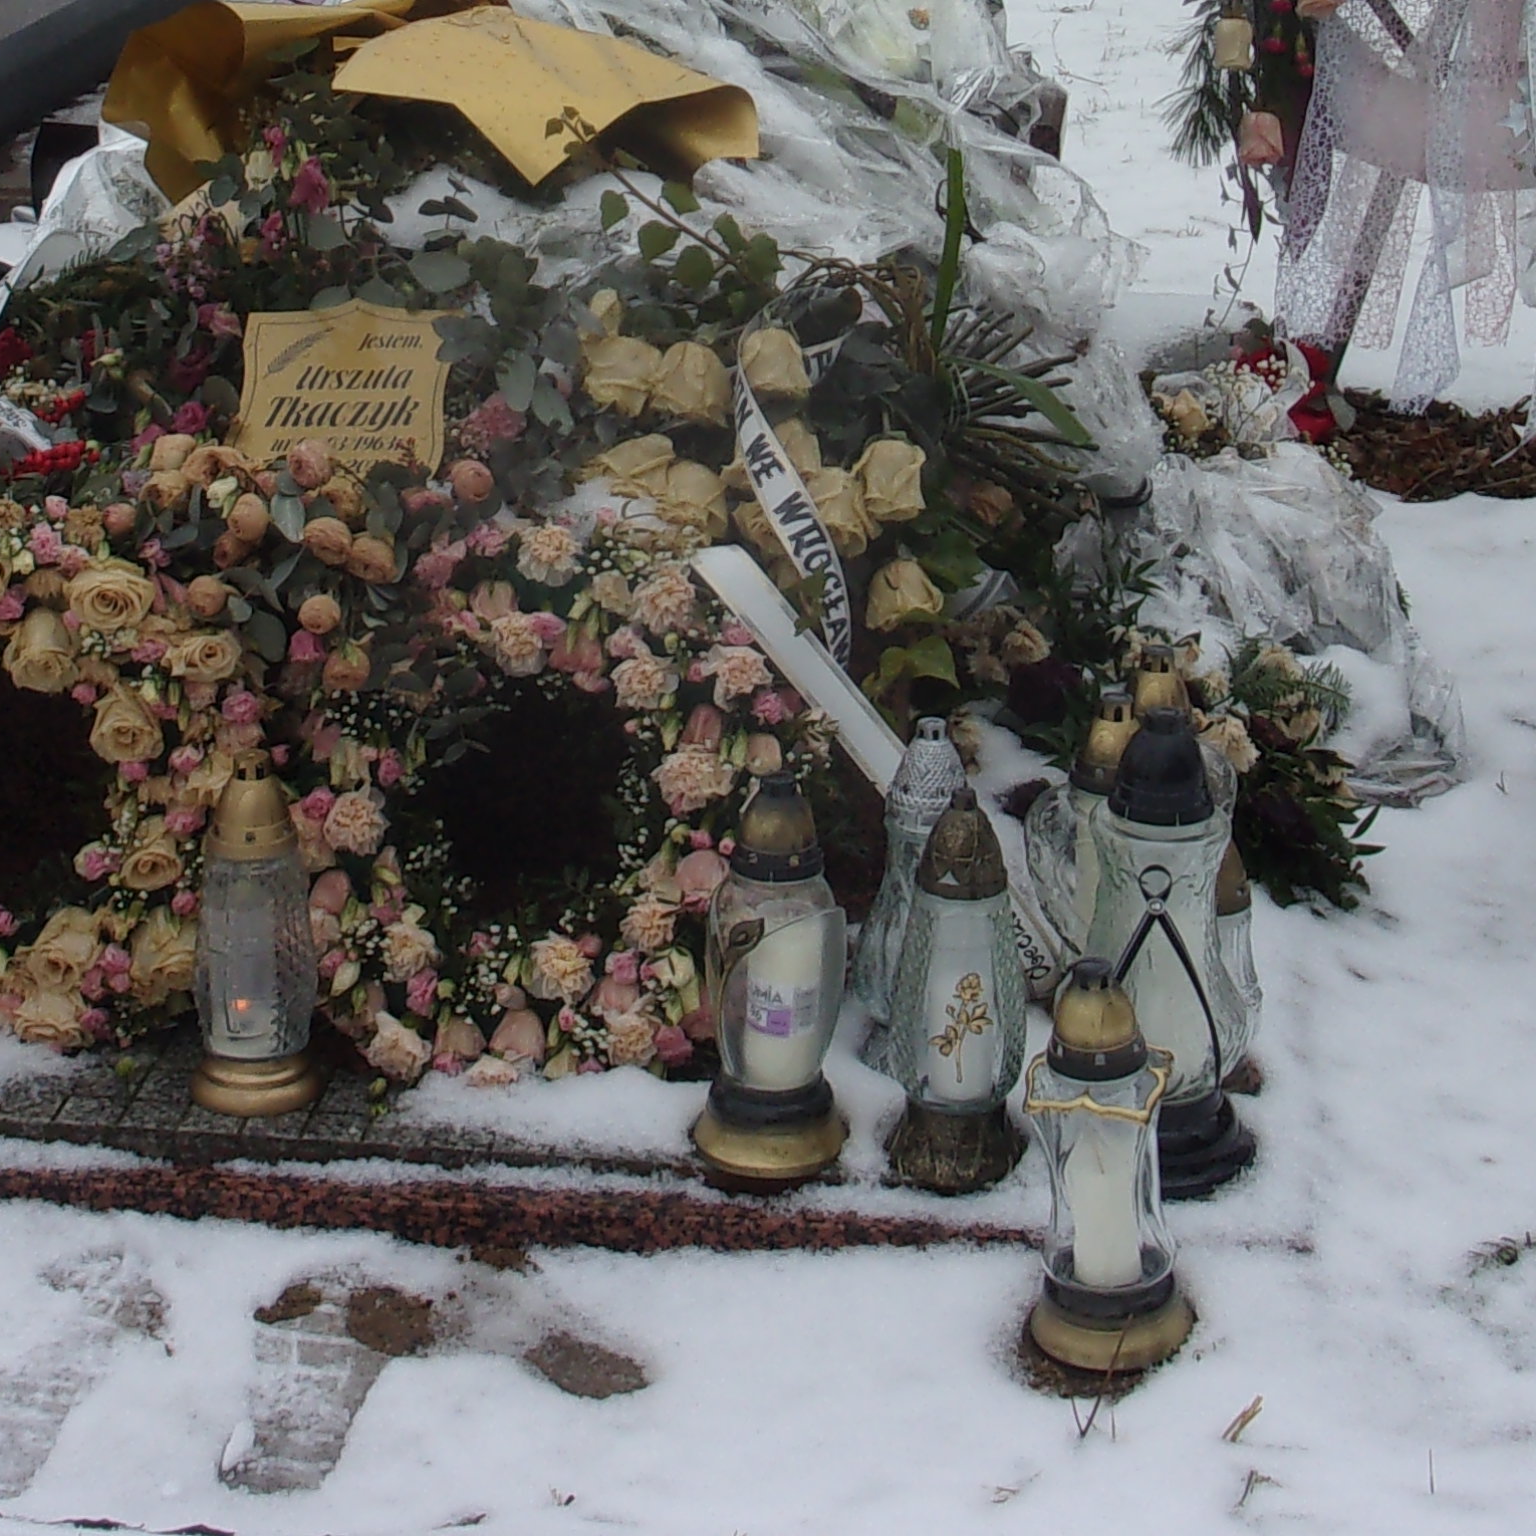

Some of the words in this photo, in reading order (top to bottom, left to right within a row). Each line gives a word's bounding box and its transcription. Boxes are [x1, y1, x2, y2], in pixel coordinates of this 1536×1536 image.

[295, 365, 414, 392] Urszula
[264, 395, 420, 432] Tkaczyk
[744, 432, 786, 490] WE
